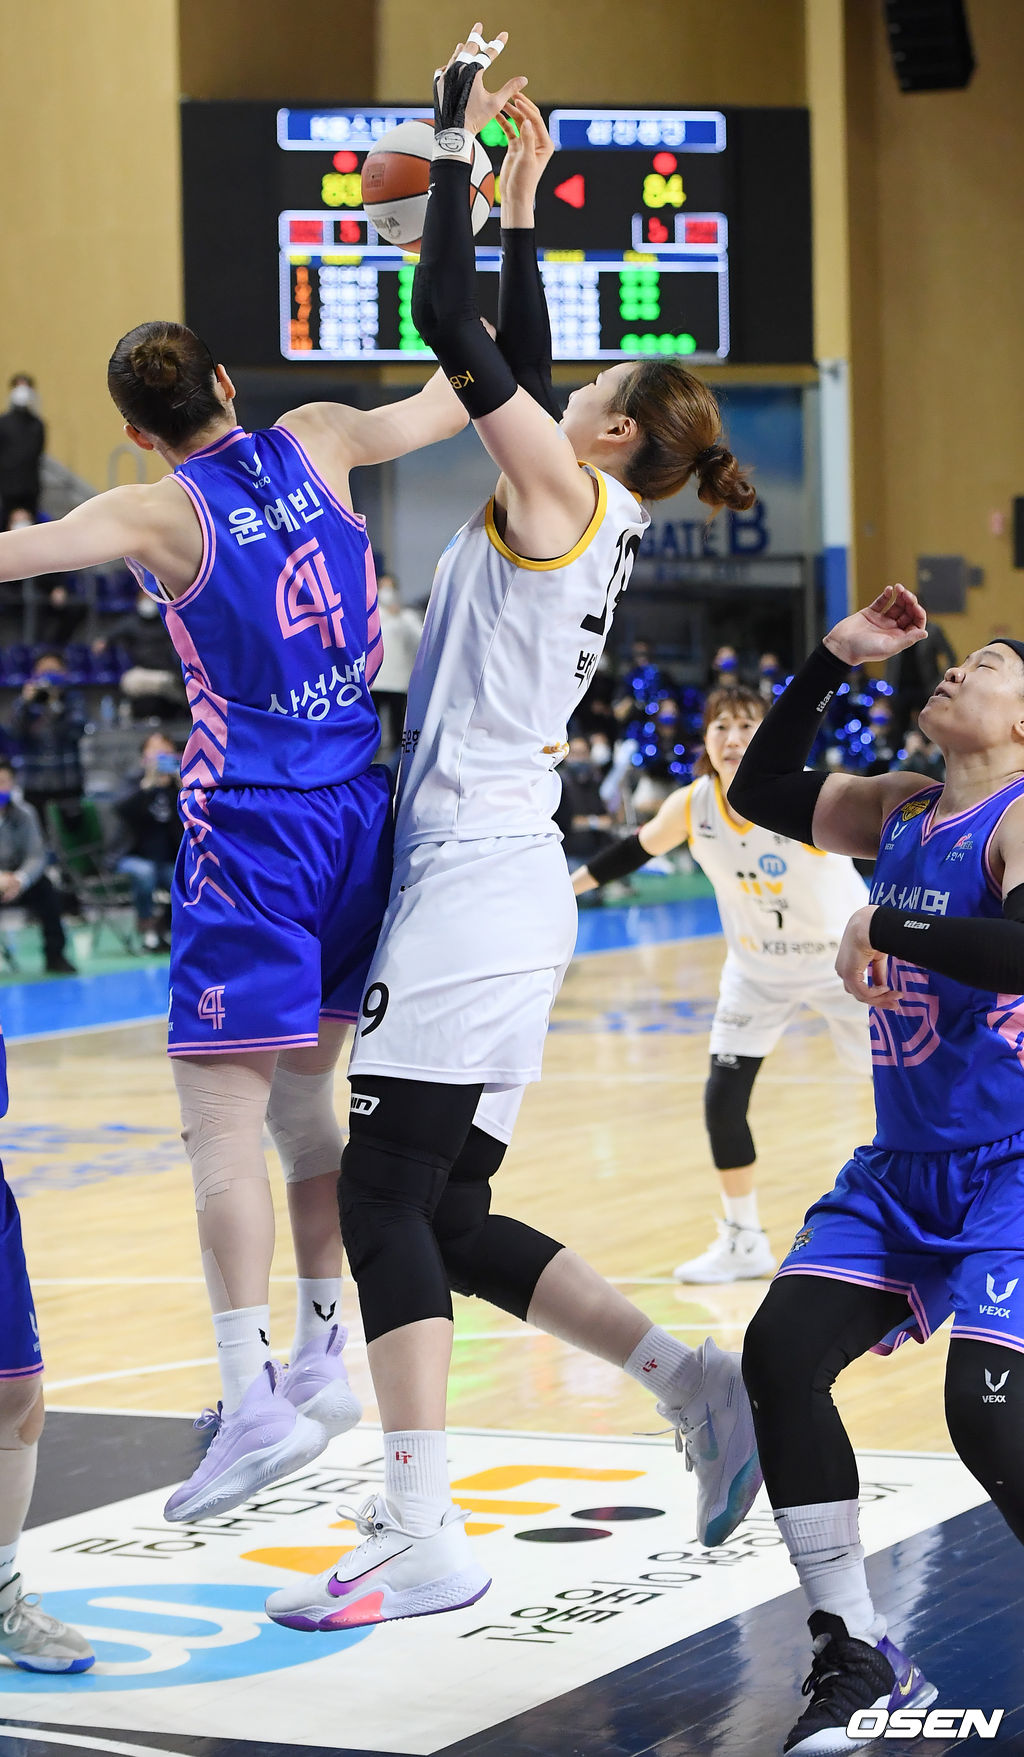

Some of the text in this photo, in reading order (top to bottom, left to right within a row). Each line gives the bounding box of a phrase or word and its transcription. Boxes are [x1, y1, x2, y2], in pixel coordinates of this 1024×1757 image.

[450, 370, 475, 389] KB
[229, 481, 324, 546] 윤예빈
[728, 496, 770, 557] B
[276, 537, 346, 649] 4
[815, 690, 834, 713] titan
[903, 920, 931, 930] titan
[198, 985, 226, 1030] 4
[361, 982, 390, 1037] 9
[979, 1304, 1011, 1319] VEXX
[982, 1395, 1007, 1404] VEXX
[458, 1571, 702, 1645] 이동통신
